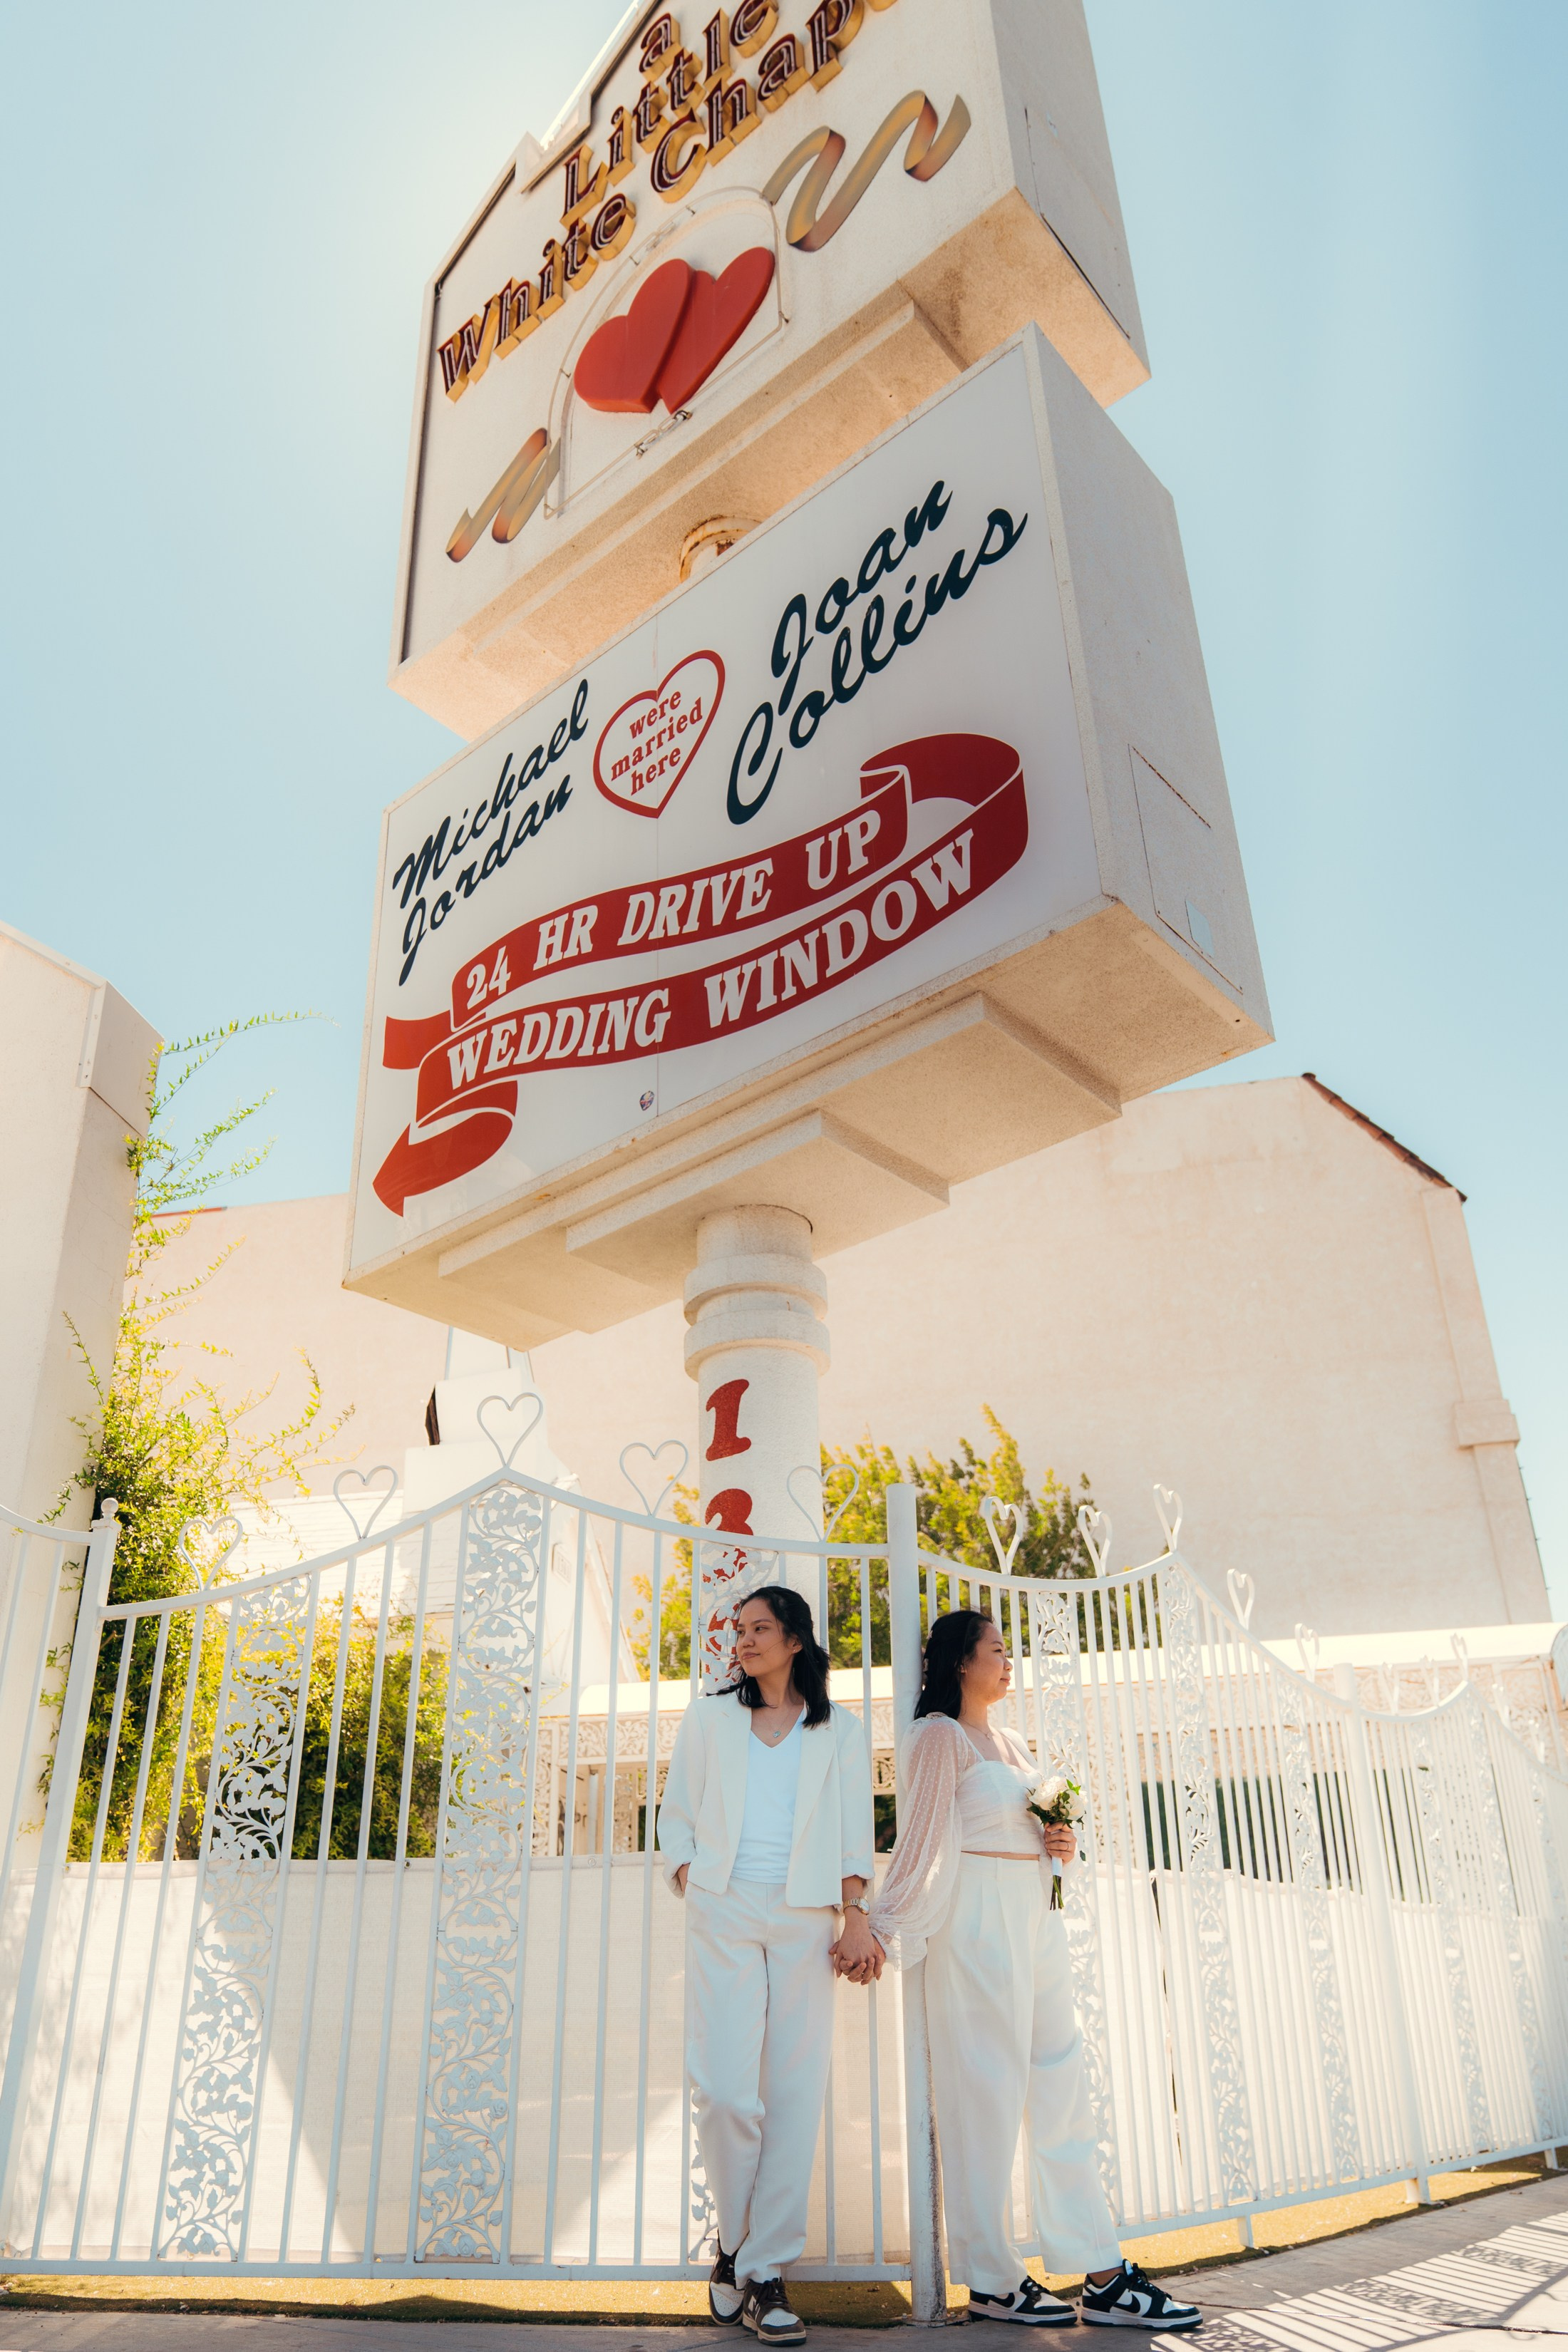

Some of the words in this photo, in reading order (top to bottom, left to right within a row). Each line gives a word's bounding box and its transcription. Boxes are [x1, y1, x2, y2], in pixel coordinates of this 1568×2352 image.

[559, 0, 780, 231] Little
[639, 12, 681, 83] a
[436, 192, 636, 403] White
[650, 0, 899, 204] Chap
[726, 507, 1028, 825] Collins
[770, 480, 954, 716] Joan
[392, 679, 589, 909] Michael
[611, 696, 703, 783] married
[629, 691, 682, 740] were
[630, 747, 682, 797] here
[398, 774, 574, 987] Jordan
[447, 987, 672, 1091] WEDDING
[703, 827, 974, 1029] WINDOW
[466, 945, 512, 1010] 24
[532, 904, 599, 971] HR
[617, 857, 774, 947] DRIVE
[805, 809, 882, 891] UP
